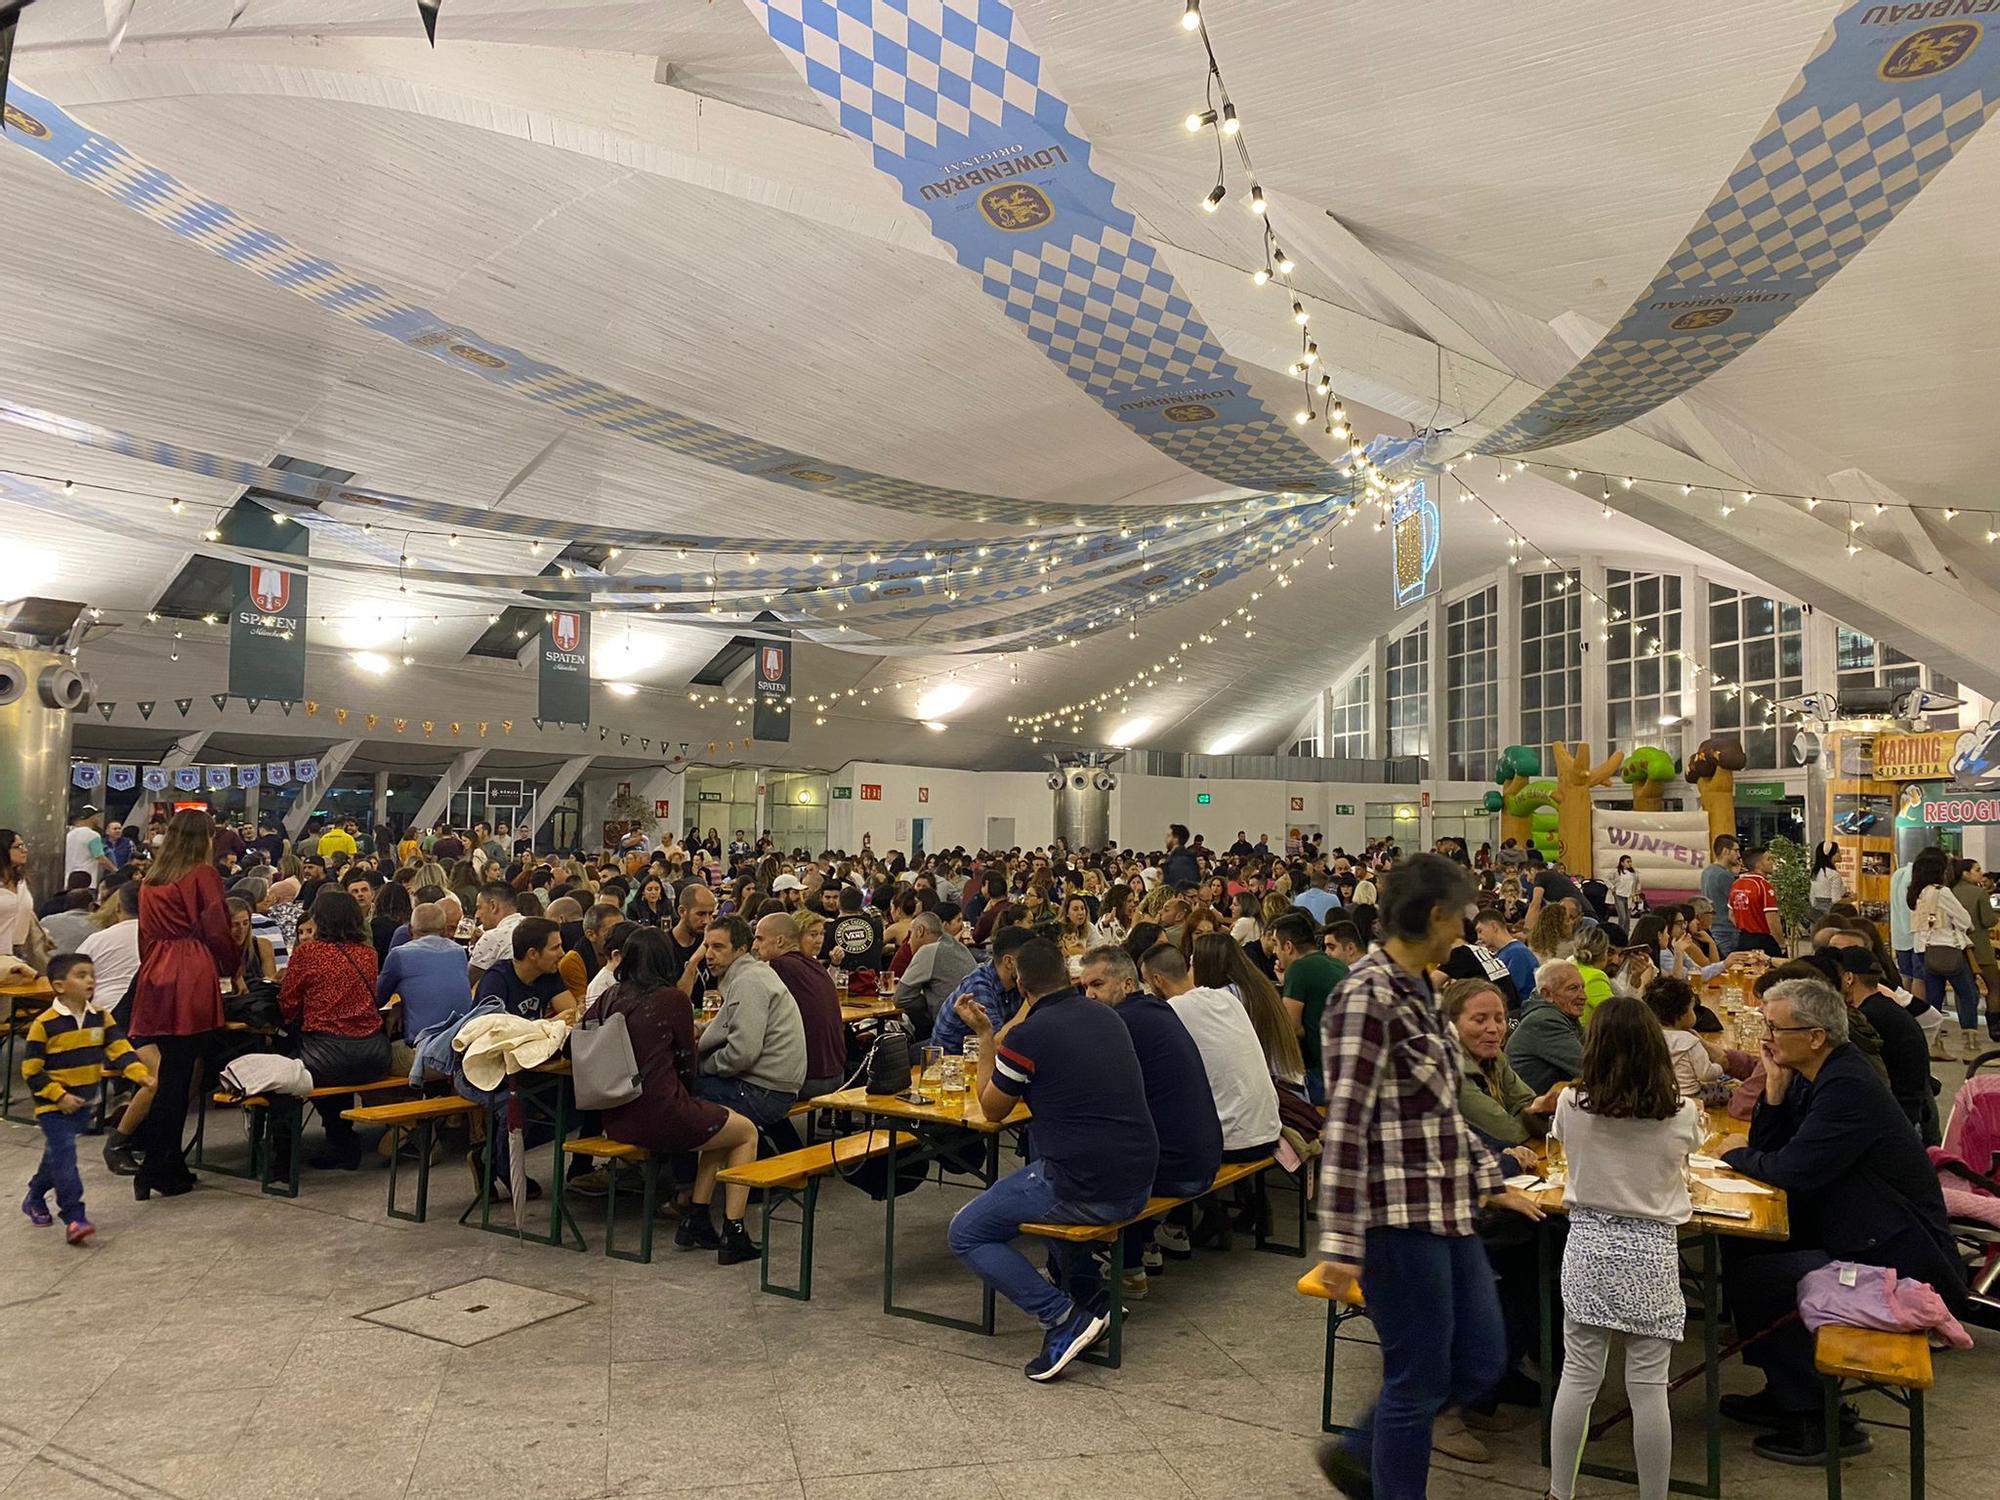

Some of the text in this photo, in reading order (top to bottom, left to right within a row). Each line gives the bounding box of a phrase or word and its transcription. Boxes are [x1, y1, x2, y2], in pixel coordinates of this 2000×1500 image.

[939, 143, 1024, 175] ORIGINAL
[920, 144, 1069, 201] LÖWENBRÄU
[240, 612, 297, 629] SPAEN
[545, 651, 585, 665] SPATEN
[758, 681, 786, 692] SPATEN
[1879, 735, 1941, 766] KARTING
[1878, 764, 1940, 777] SIDRERIA
[1924, 799, 2000, 823] RECOGI
[1607, 826, 1706, 869] WINTER
[844, 930, 866, 940] VANS
